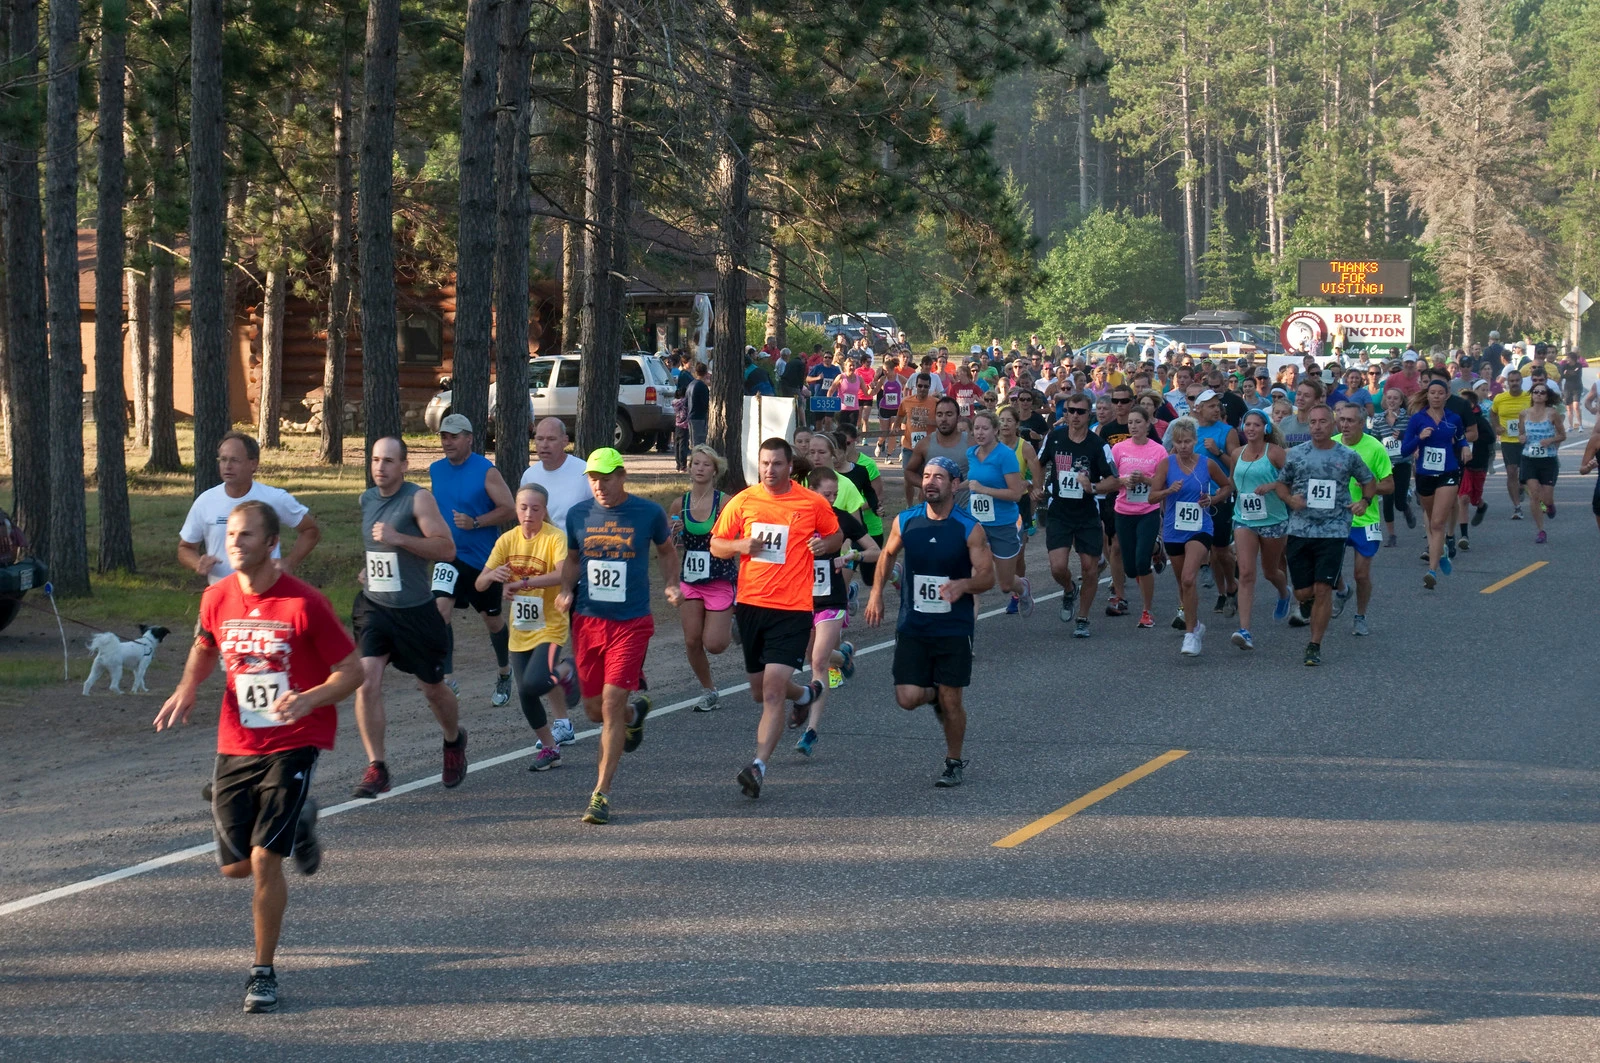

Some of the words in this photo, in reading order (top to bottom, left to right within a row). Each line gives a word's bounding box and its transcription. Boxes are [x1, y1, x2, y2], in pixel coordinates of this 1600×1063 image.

[1329, 261, 1378, 273] THANKS
[1341, 272, 1366, 283] FOR
[1321, 283, 1384, 294] VISTING!
[1303, 312, 1321, 323] CAPITAL
[1334, 313, 1402, 324] BOULDER
[816, 400, 835, 409] 5352
[1385, 440, 1399, 449] 408
[1531, 446, 1545, 455] 735
[1426, 451, 1442, 463] 703
[1061, 476, 1079, 489] 441
[1311, 485, 1331, 498] 451
[973, 499, 990, 512] 409
[1243, 497, 1262, 511] 449
[1179, 507, 1199, 521] 450
[756, 531, 782, 550] 444
[370, 560, 394, 578] 381
[686, 556, 705, 572] 419
[433, 567, 455, 583] 389
[593, 568, 620, 587] 382
[516, 602, 539, 620] 368
[226, 628, 284, 643] FINAL
[220, 640, 292, 655] FOUR
[246, 684, 279, 709] 437
